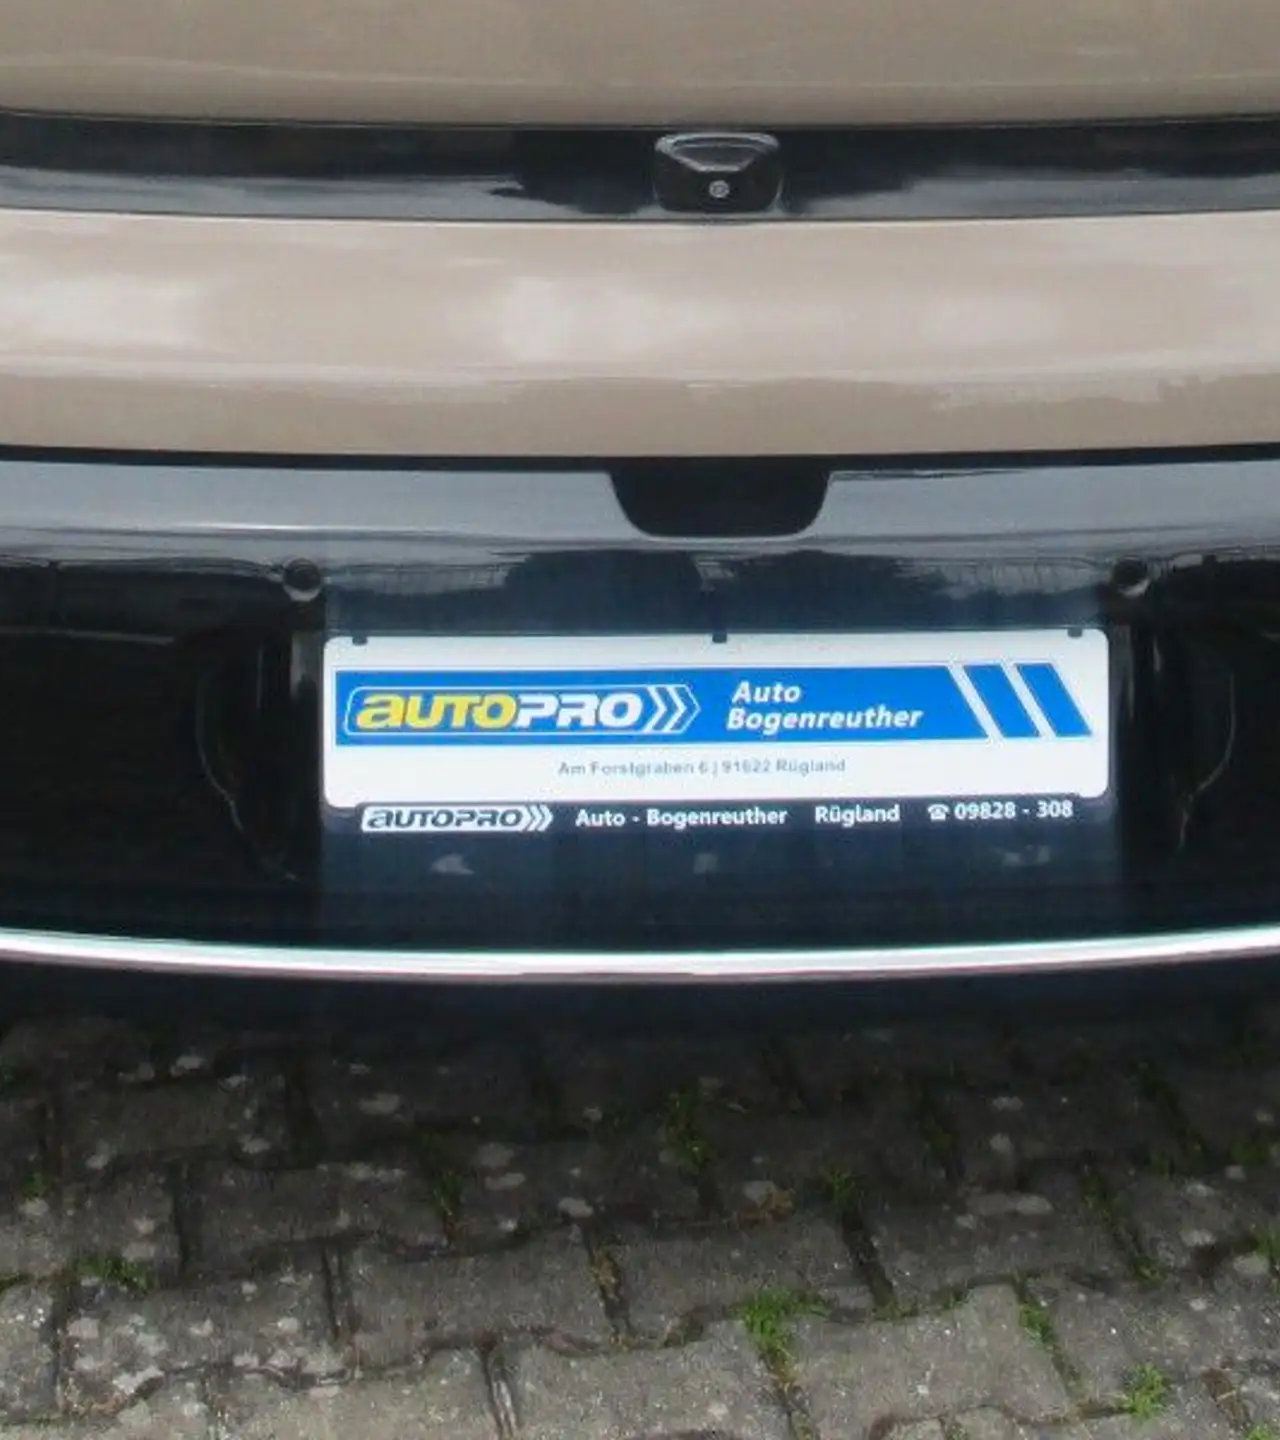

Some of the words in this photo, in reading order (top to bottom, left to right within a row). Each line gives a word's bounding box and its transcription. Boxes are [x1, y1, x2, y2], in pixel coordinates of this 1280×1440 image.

[731, 680, 802, 704] Auto
[726, 704, 923, 735] Bogenreuther
[558, 760, 587, 776] Am
[775, 758, 846, 778] Rügland
[574, 808, 626, 828] Auto
[645, 806, 788, 832] Bogenreuther
[814, 803, 901, 828] Rügland
[953, 802, 1016, 821] 09828
[1036, 800, 1074, 820] 308
